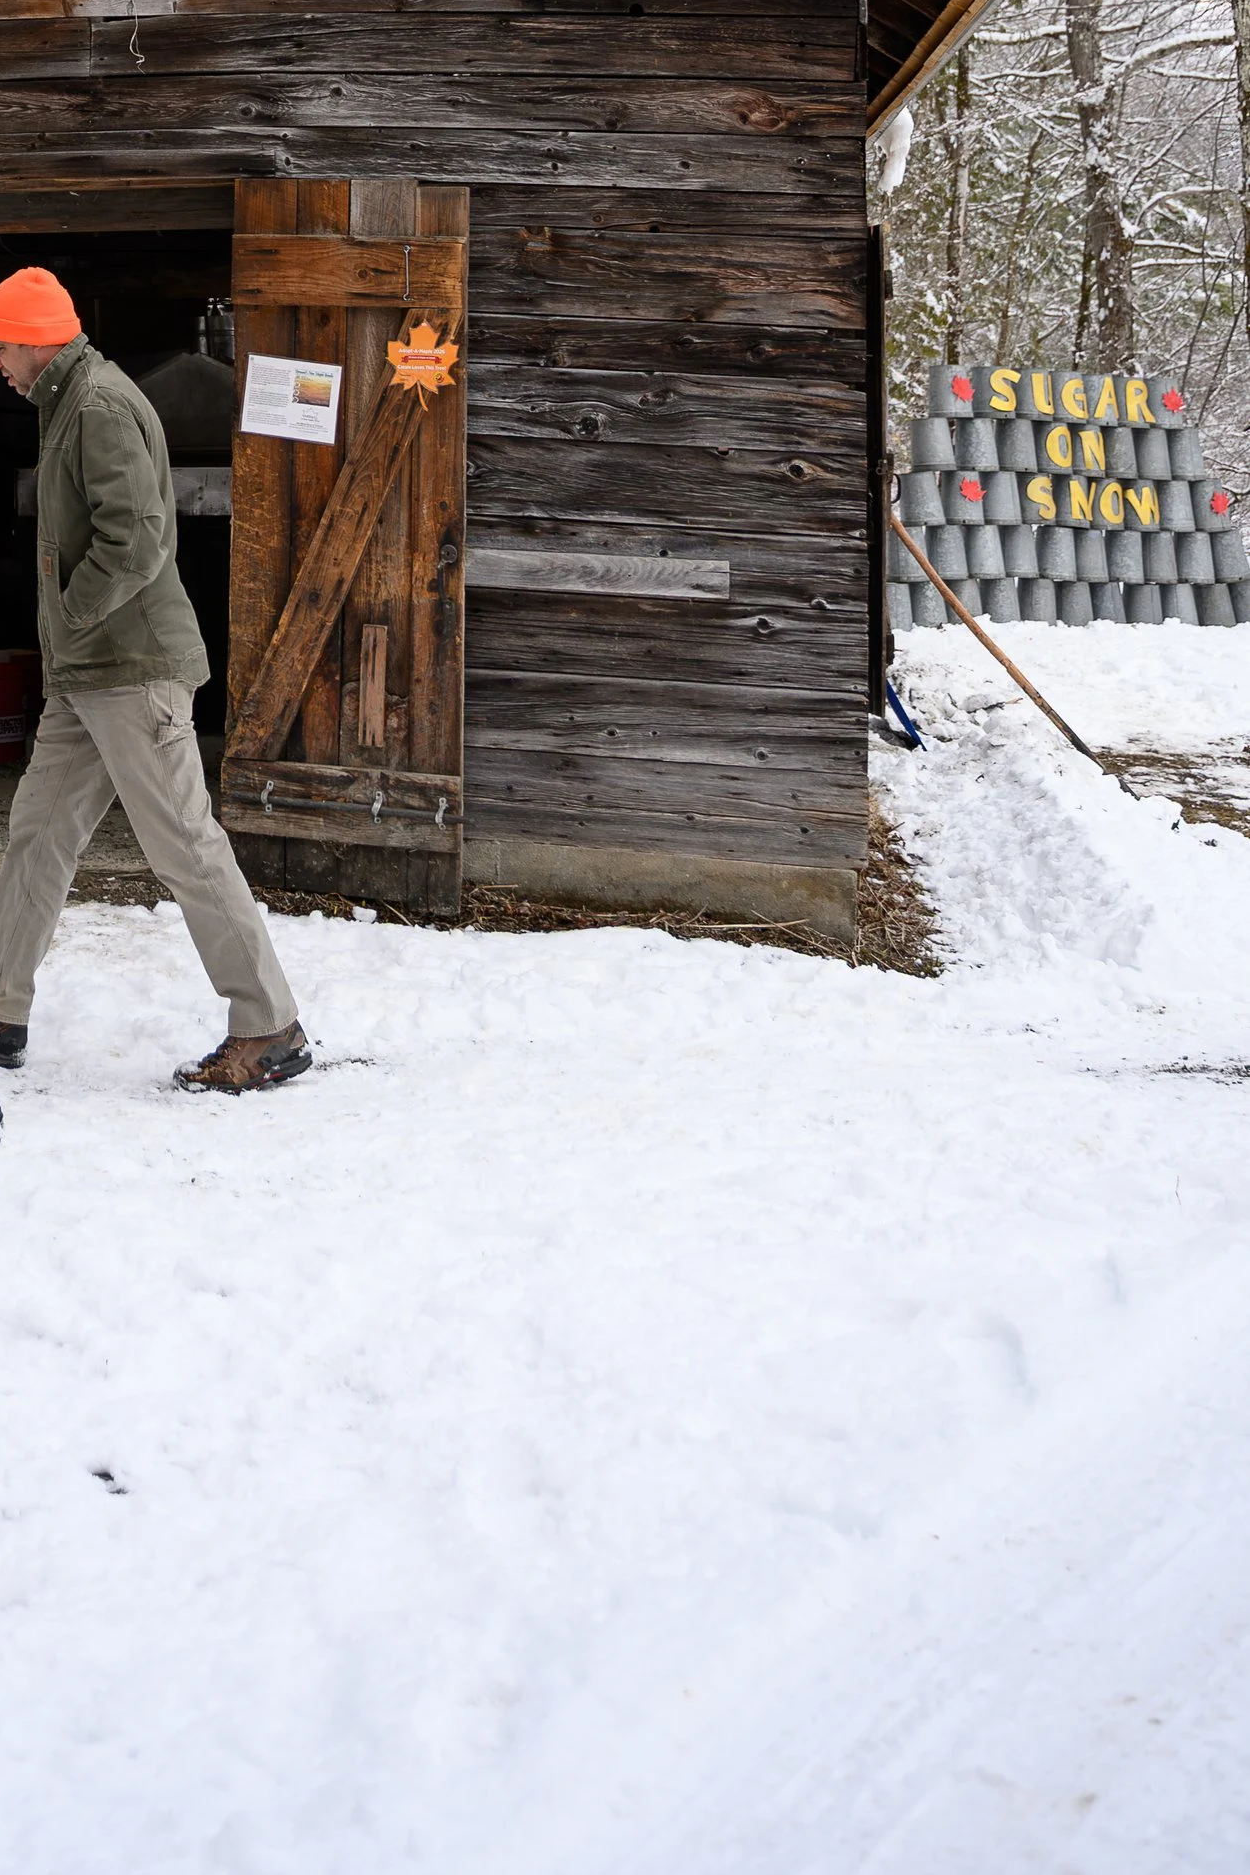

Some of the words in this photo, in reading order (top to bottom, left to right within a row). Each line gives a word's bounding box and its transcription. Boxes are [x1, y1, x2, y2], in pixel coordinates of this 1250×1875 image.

[989, 369, 1156, 423] SUGAR
[1046, 426, 1106, 471] ON
[1026, 476, 1160, 525] SNOW
